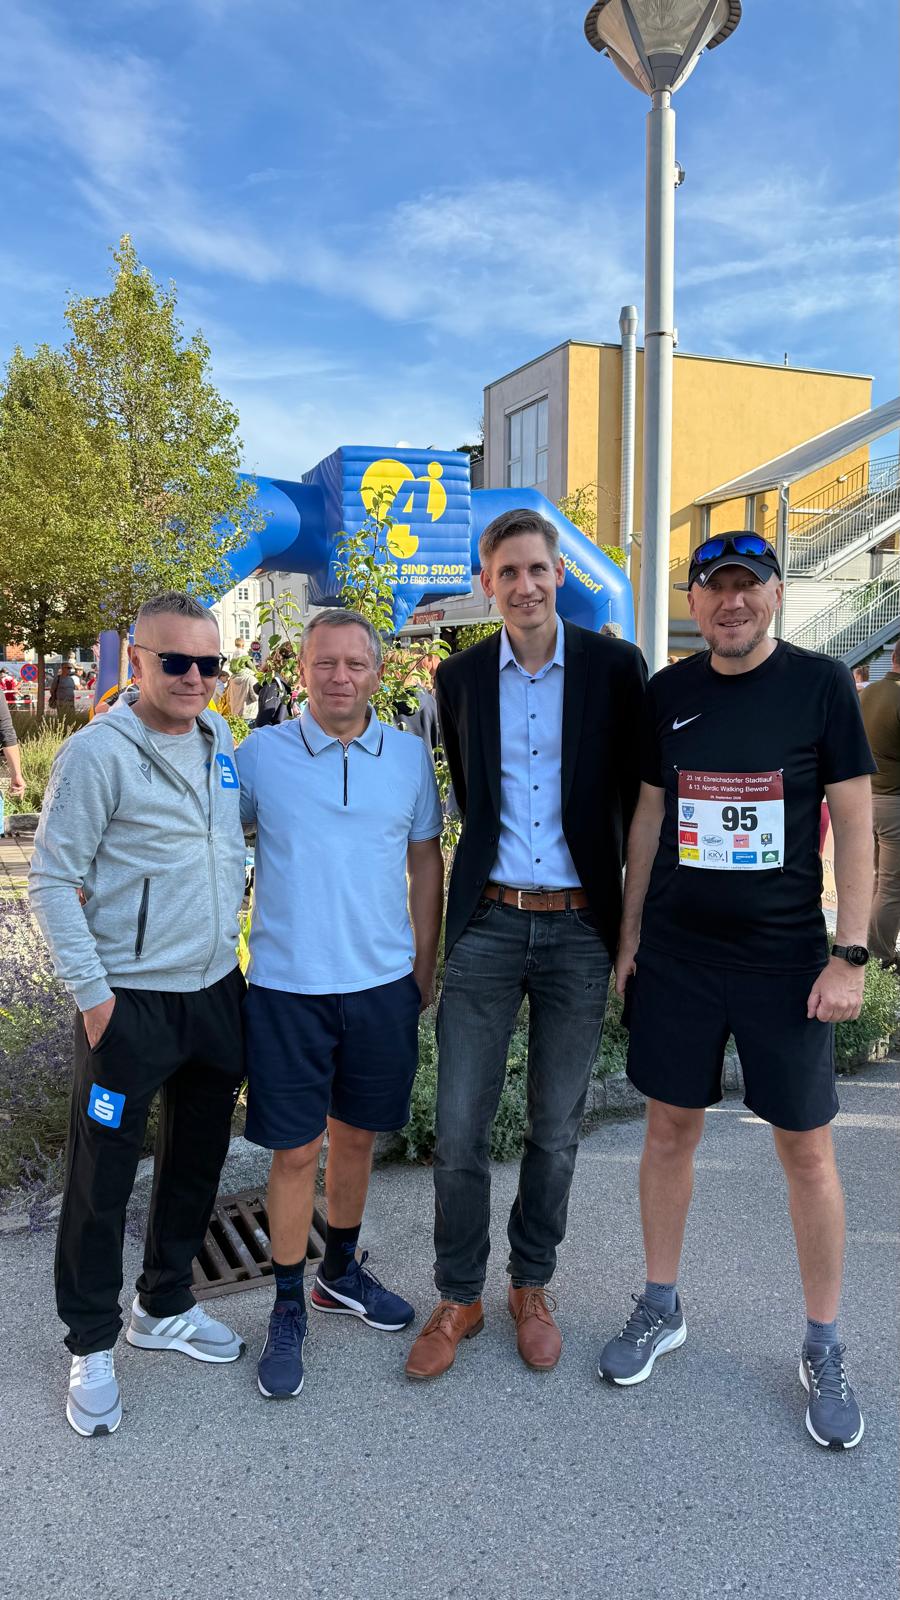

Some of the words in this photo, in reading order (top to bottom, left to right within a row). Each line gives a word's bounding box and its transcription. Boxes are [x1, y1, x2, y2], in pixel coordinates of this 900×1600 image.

[401, 564, 429, 575] SIND
[431, 564, 466, 576] STADT.
[720, 786, 744, 794] Walking
[721, 806, 758, 831] 95
